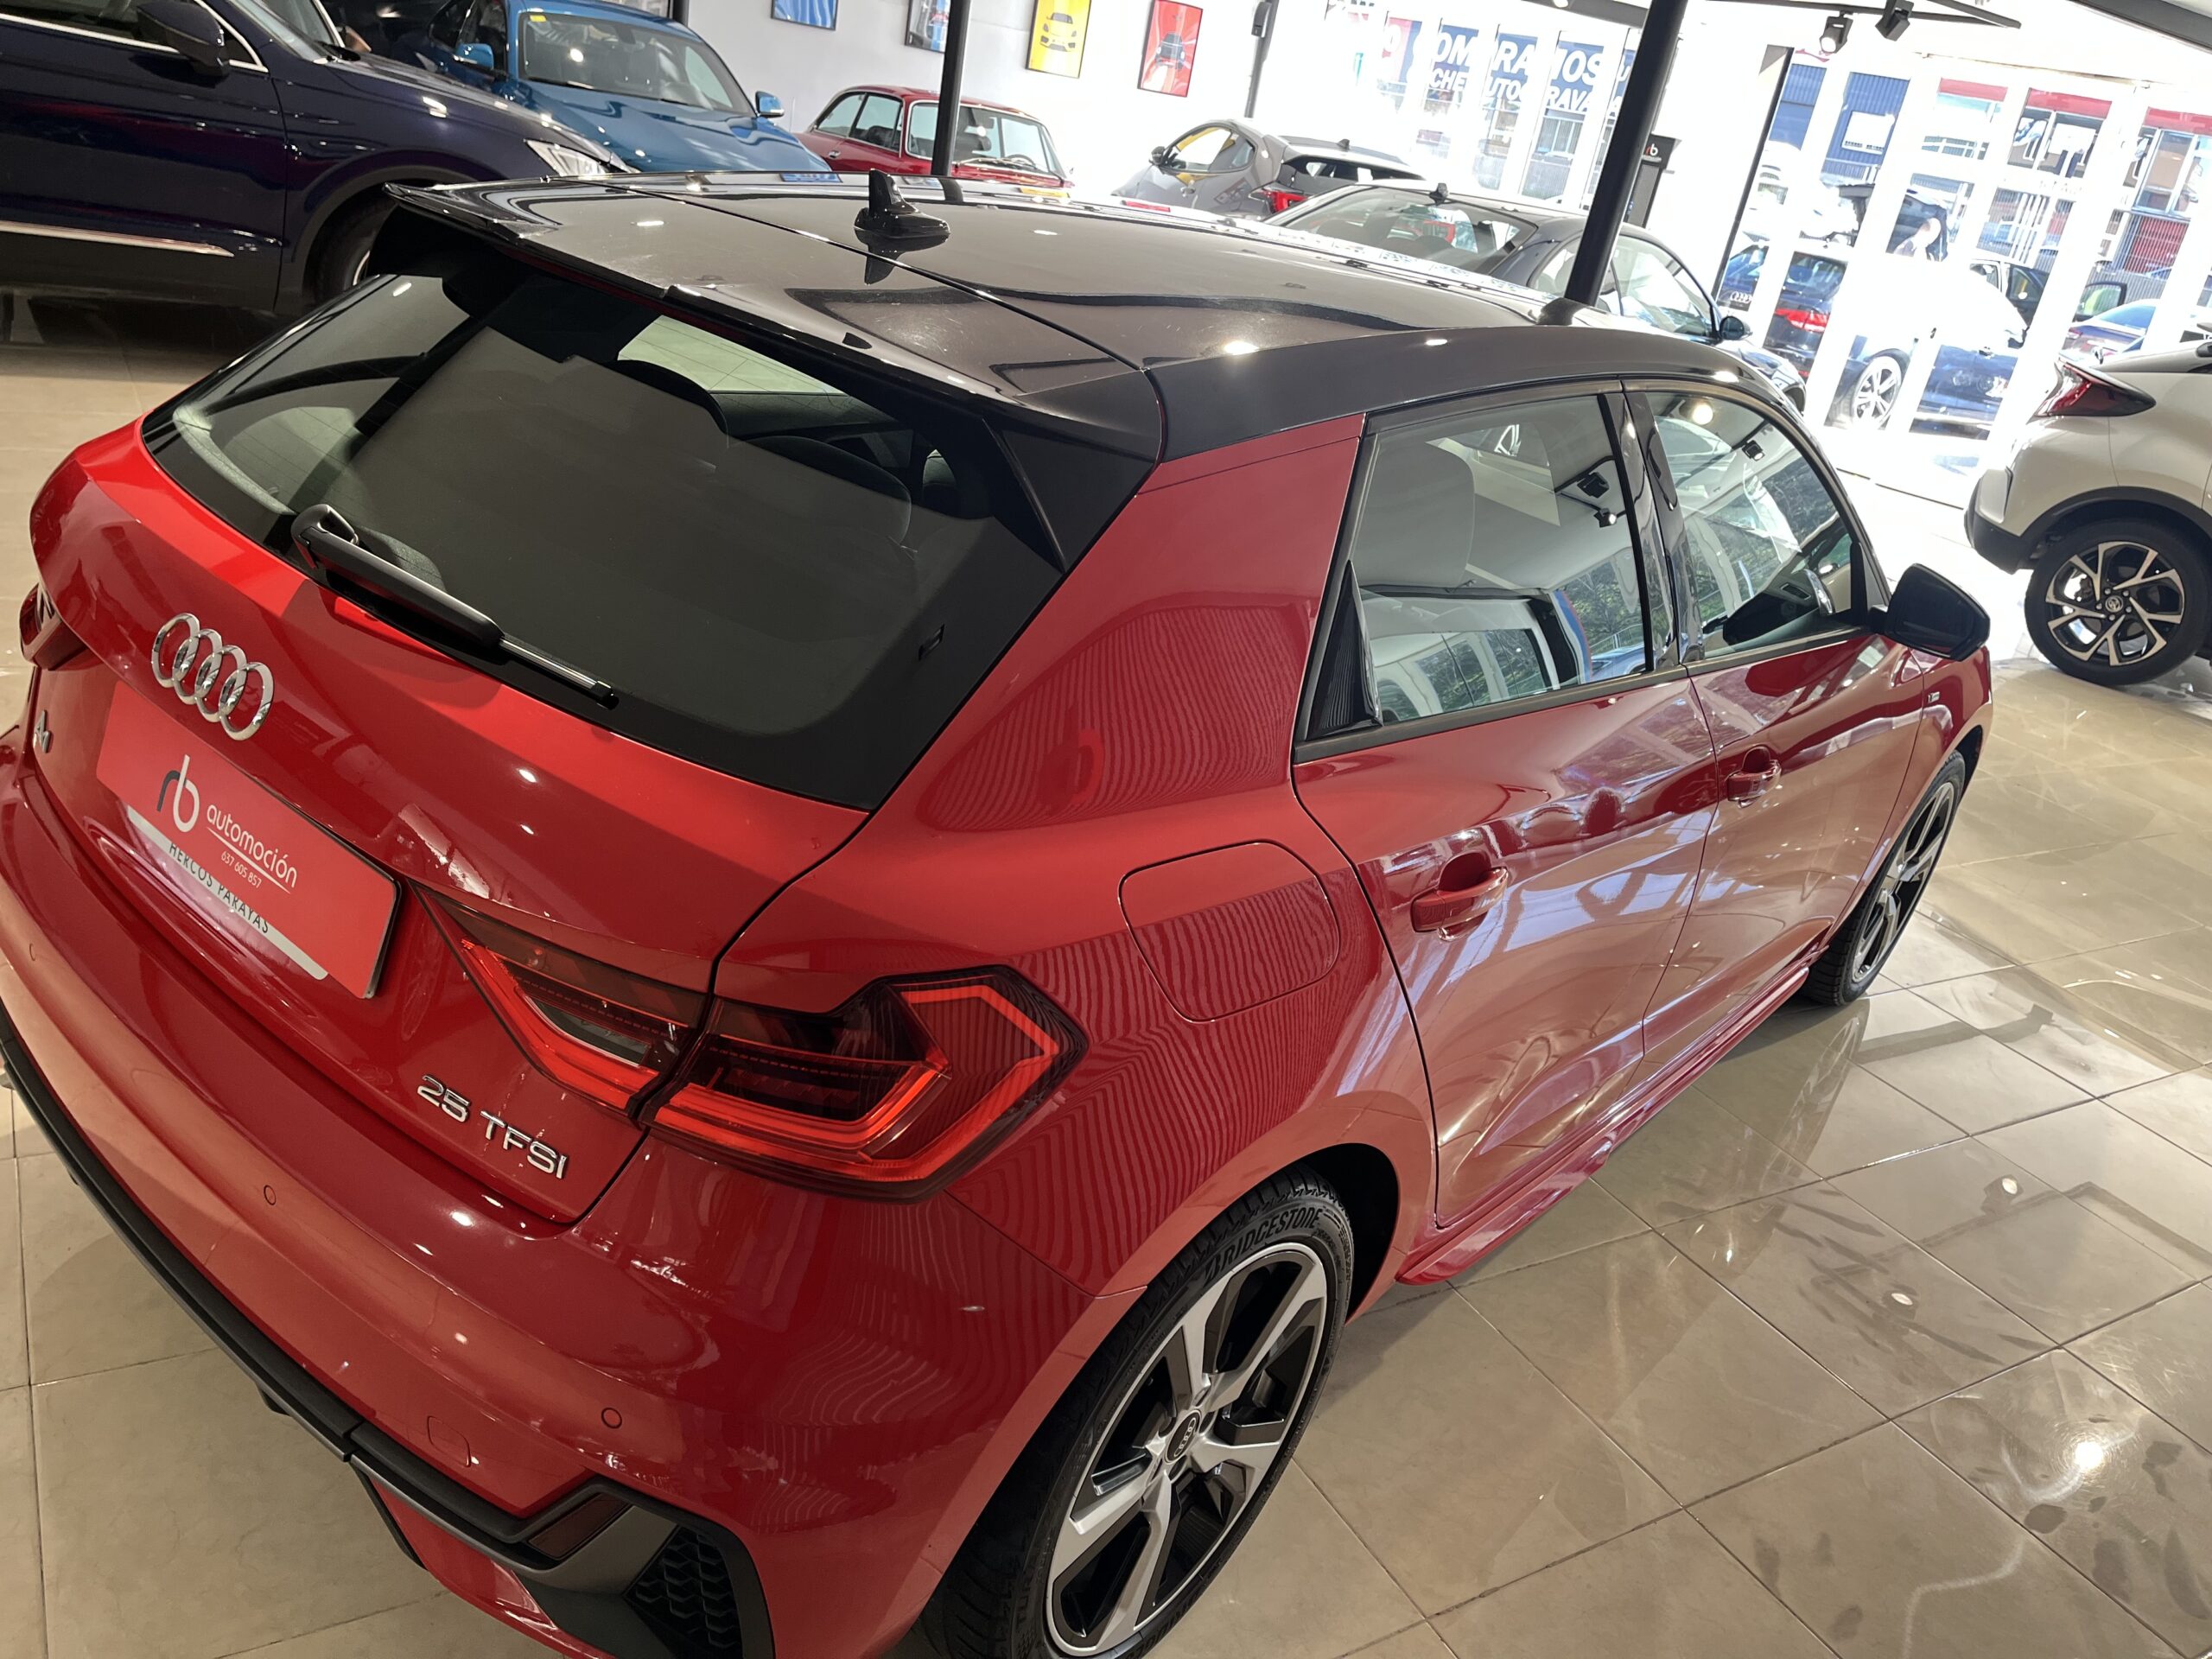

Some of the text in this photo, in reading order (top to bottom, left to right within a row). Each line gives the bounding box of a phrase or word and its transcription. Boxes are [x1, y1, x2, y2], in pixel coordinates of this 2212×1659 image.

[168, 842, 269, 934] HERCOS PARAYAS
[207, 804, 297, 888] automoción
[220, 850, 263, 889] 637 605 857
[416, 1075, 568, 1179] 25 TFSI
[1203, 1205, 1324, 1287] BRIDGESTONE
